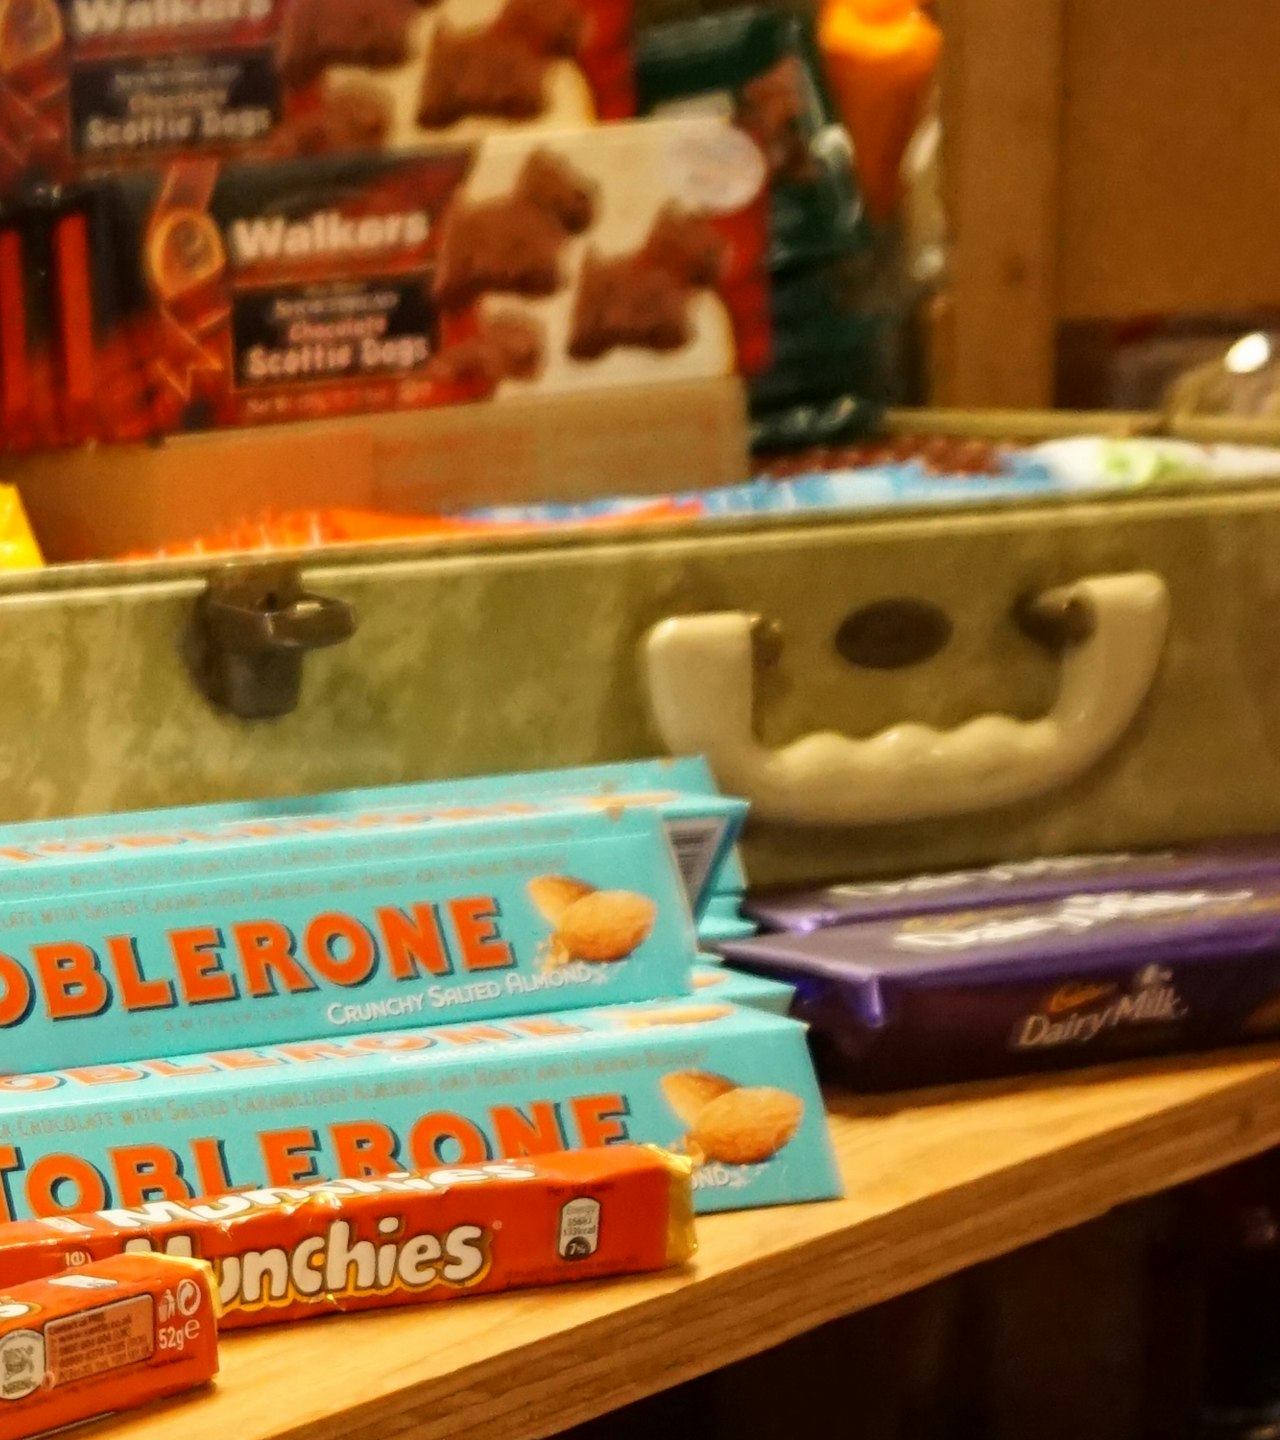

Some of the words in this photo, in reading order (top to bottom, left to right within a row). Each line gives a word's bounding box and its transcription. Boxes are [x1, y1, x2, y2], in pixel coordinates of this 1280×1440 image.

[230, 210, 429, 258] Walkers
[246, 345, 351, 378] Scottie
[360, 335, 430, 369] Dogs
[326, 993, 425, 1027] CRUNCHY
[427, 976, 503, 1012] SALTED
